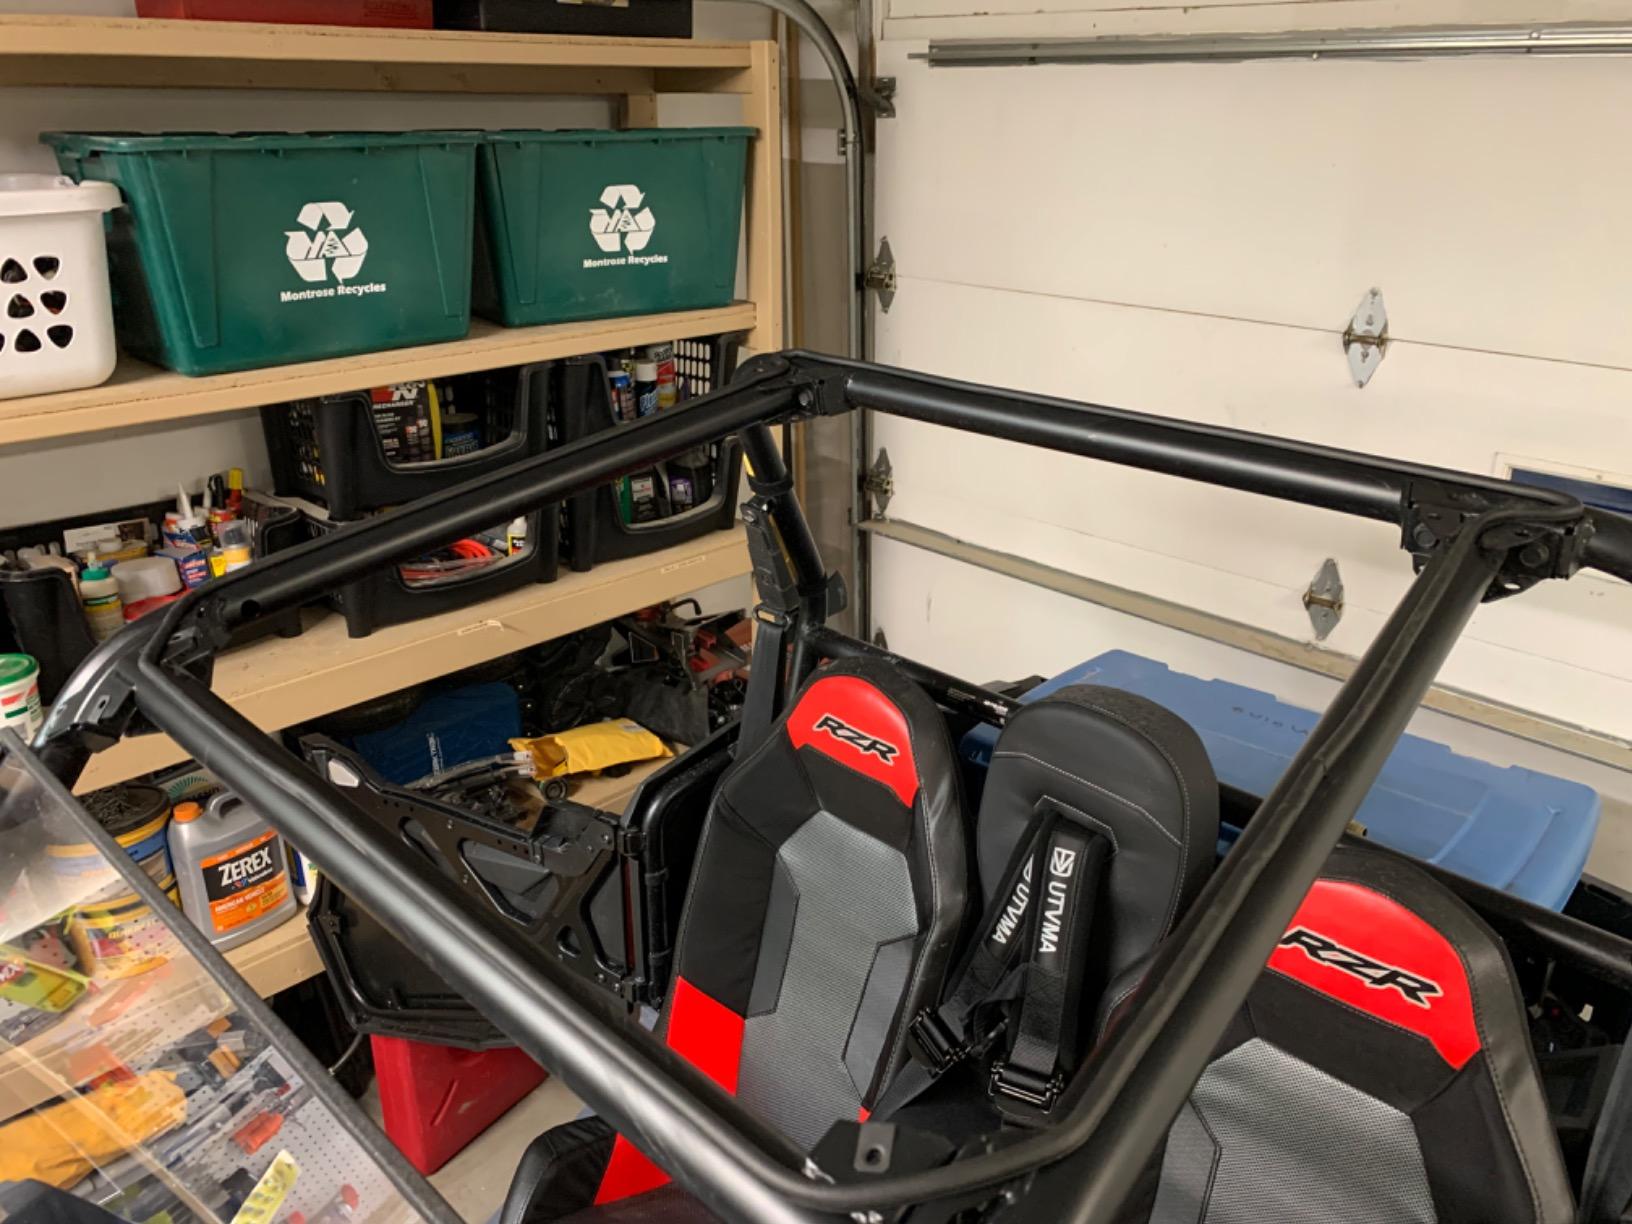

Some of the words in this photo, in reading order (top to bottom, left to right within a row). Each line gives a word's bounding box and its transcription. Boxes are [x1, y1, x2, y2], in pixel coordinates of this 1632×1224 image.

[582, 258, 626, 269] Montrose
[627, 254, 668, 266] Recycles
[281, 288, 335, 302] Montrose
[336, 283, 386, 297] Recycles
[813, 713, 899, 766] RZR
[218, 847, 272, 887] ZEREX
[992, 882, 1031, 944] UTVMA
[1039, 881, 1068, 952] UTVMA
[1279, 926, 1443, 1009] RZR
